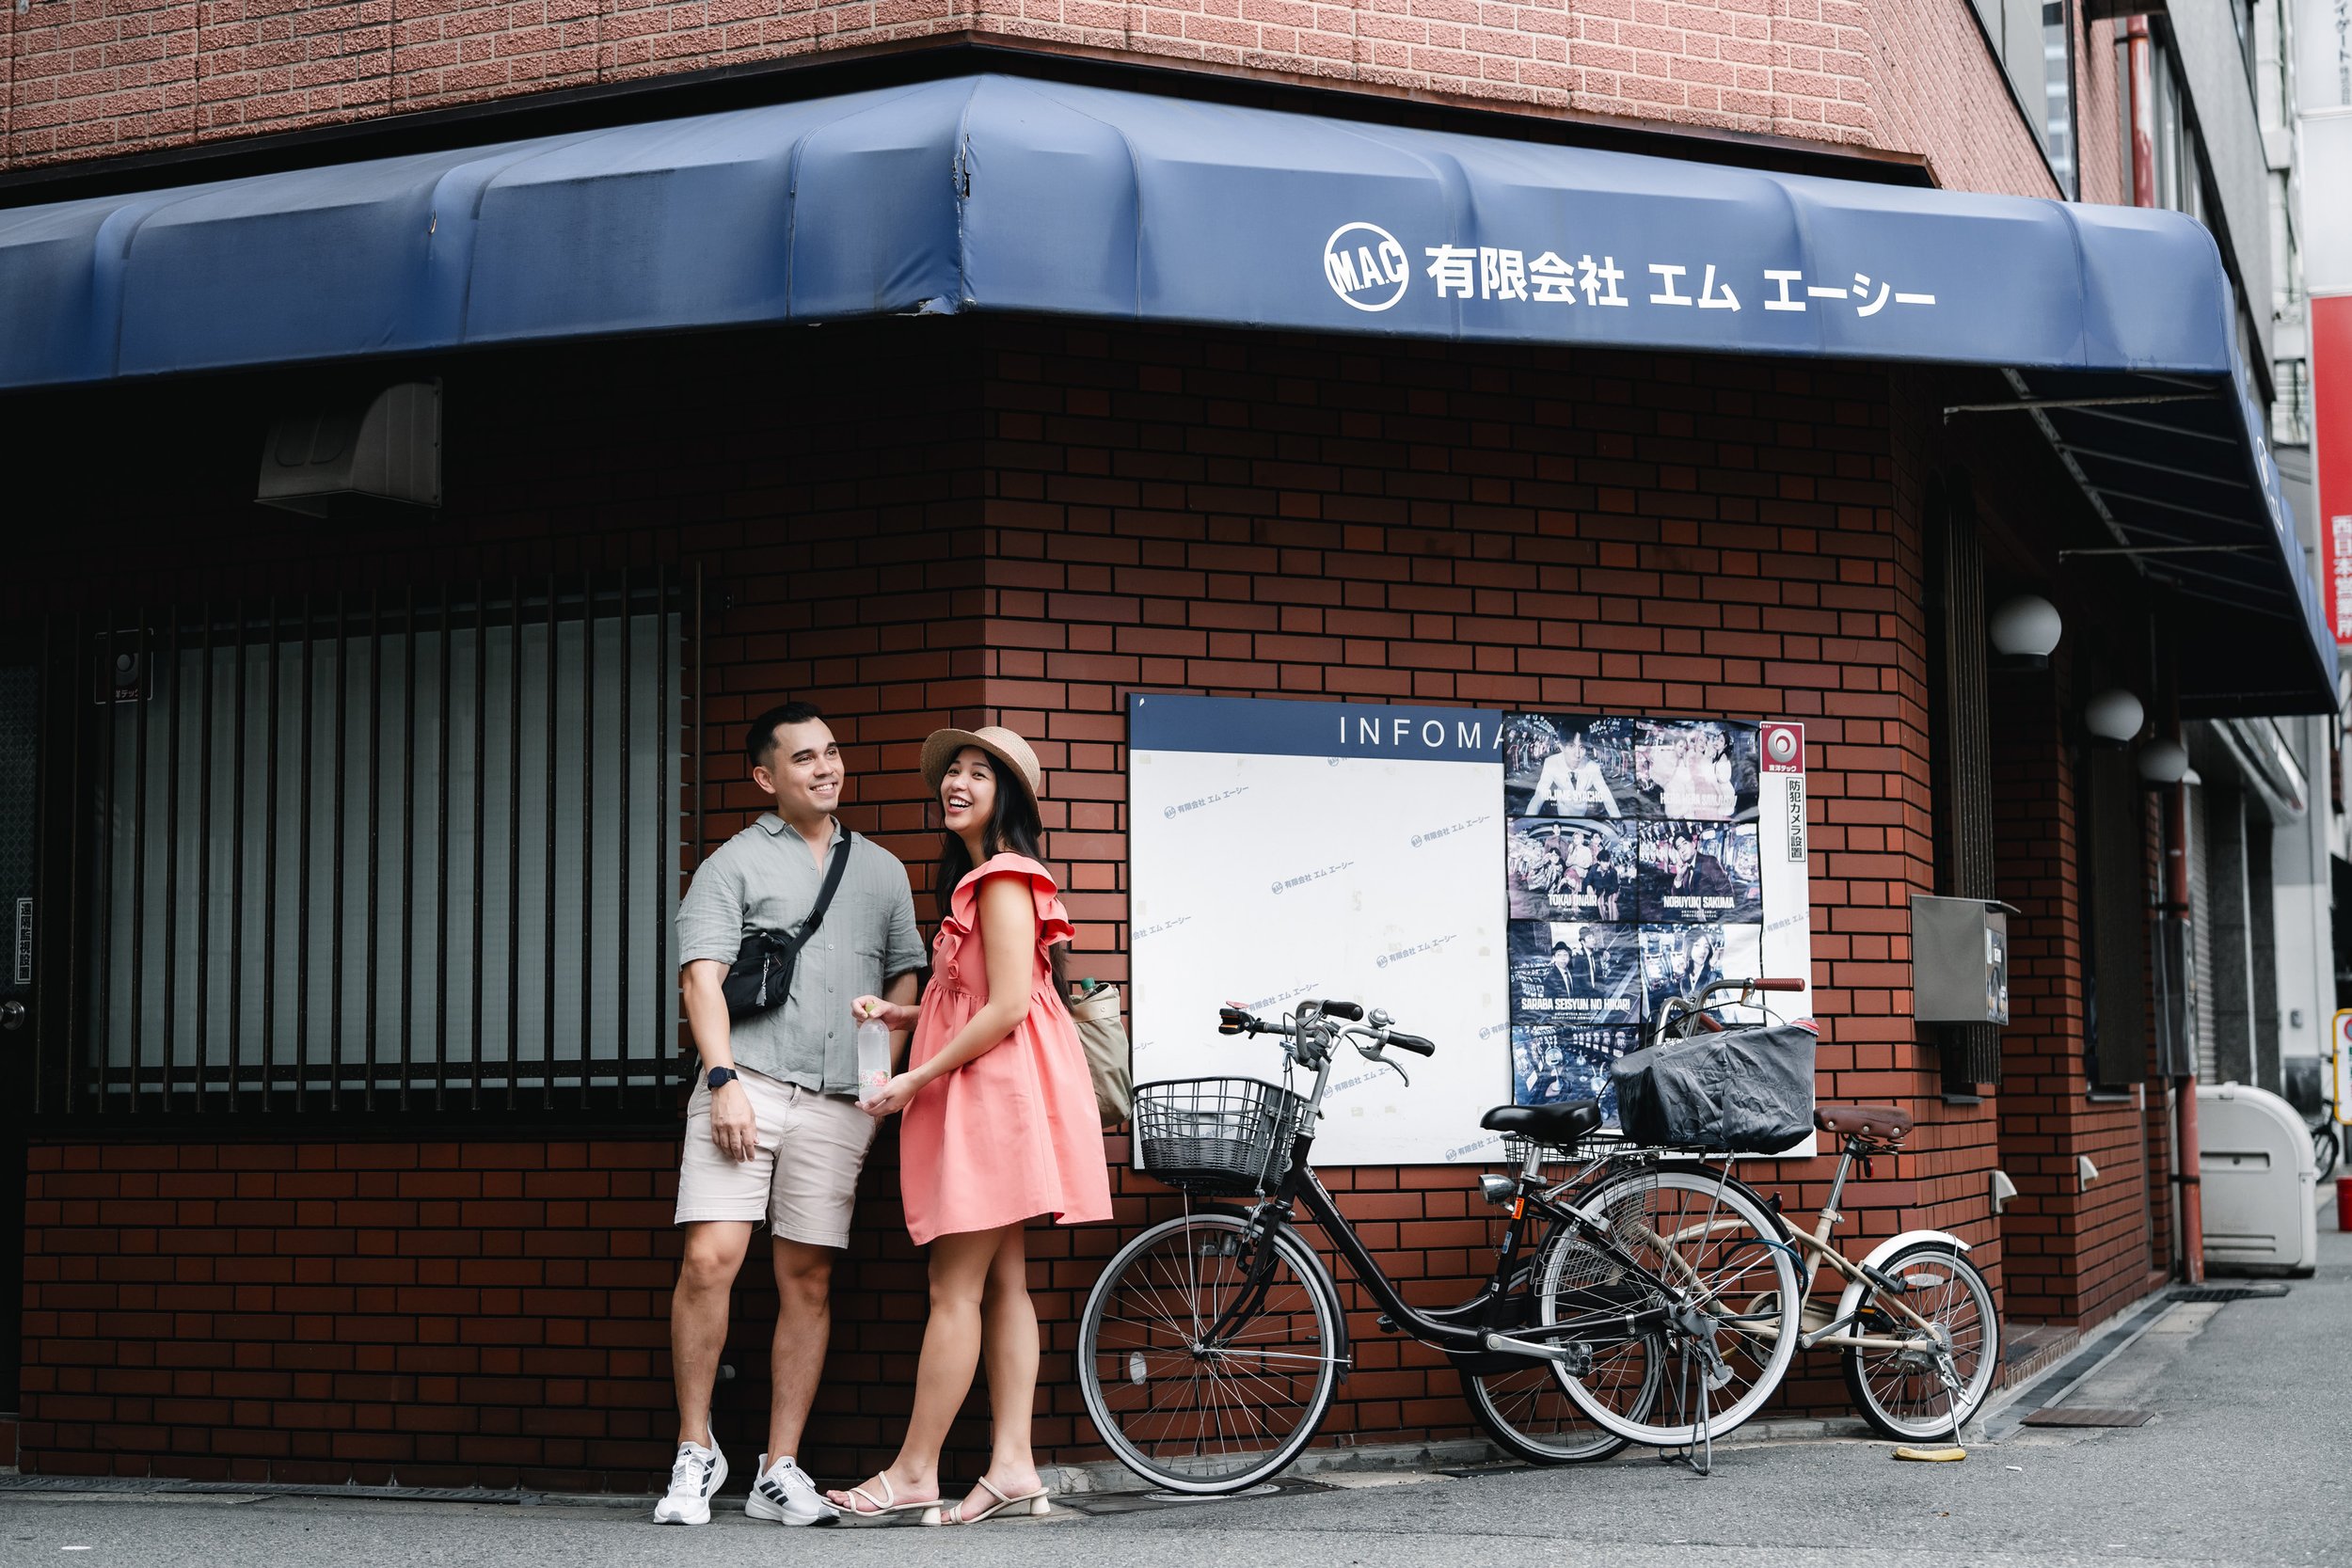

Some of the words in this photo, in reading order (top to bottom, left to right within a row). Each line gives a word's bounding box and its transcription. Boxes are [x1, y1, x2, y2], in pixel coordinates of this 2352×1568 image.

[1424, 244, 1629, 308] 有限会社
[1648, 263, 1741, 312] エム
[1764, 269, 1936, 318] エーシー
[1768, 764, 1797, 773] 東洋テック
[1177, 799, 1206, 814] 有限会社
[1207, 794, 1221, 804] エム
[1223, 785, 1249, 799] エーシー
[1423, 827, 1451, 842] 有限会社
[1452, 822, 1465, 832] エム
[1466, 816, 1490, 827] エーシー
[1788, 780, 1803, 858] 防犯カメラ設置
[1284, 873, 1312, 889] 有限会社
[1313, 869, 1327, 879] エム
[1328, 861, 1355, 874] エーシー
[1548, 894, 1571, 907] TOKAI
[1663, 895, 1702, 909] NOBUYUKI
[1703, 896, 1735, 909] SAKUMA
[1149, 925, 1163, 934] エム
[1165, 915, 1192, 928] エーシー
[19, 903, 32, 979] 遠隔監視設置
[1389, 947, 1416, 962] 有限会社
[1417, 942, 1431, 952] エム
[1432, 934, 1457, 946] エーシー
[1278, 992, 1292, 1002] エム
[1294, 983, 1319, 995] エーシー
[1521, 997, 1553, 1010] SARABA
[1554, 997, 1589, 1010] SEISYUN
[1590, 998, 1602, 1010] NO
[1603, 998, 1630, 1010] HIKARI
[1334, 1077, 1361, 1093] 有限会社
[1363, 1071, 1377, 1081] エム
[1457, 1140, 1485, 1156] 有限会社
